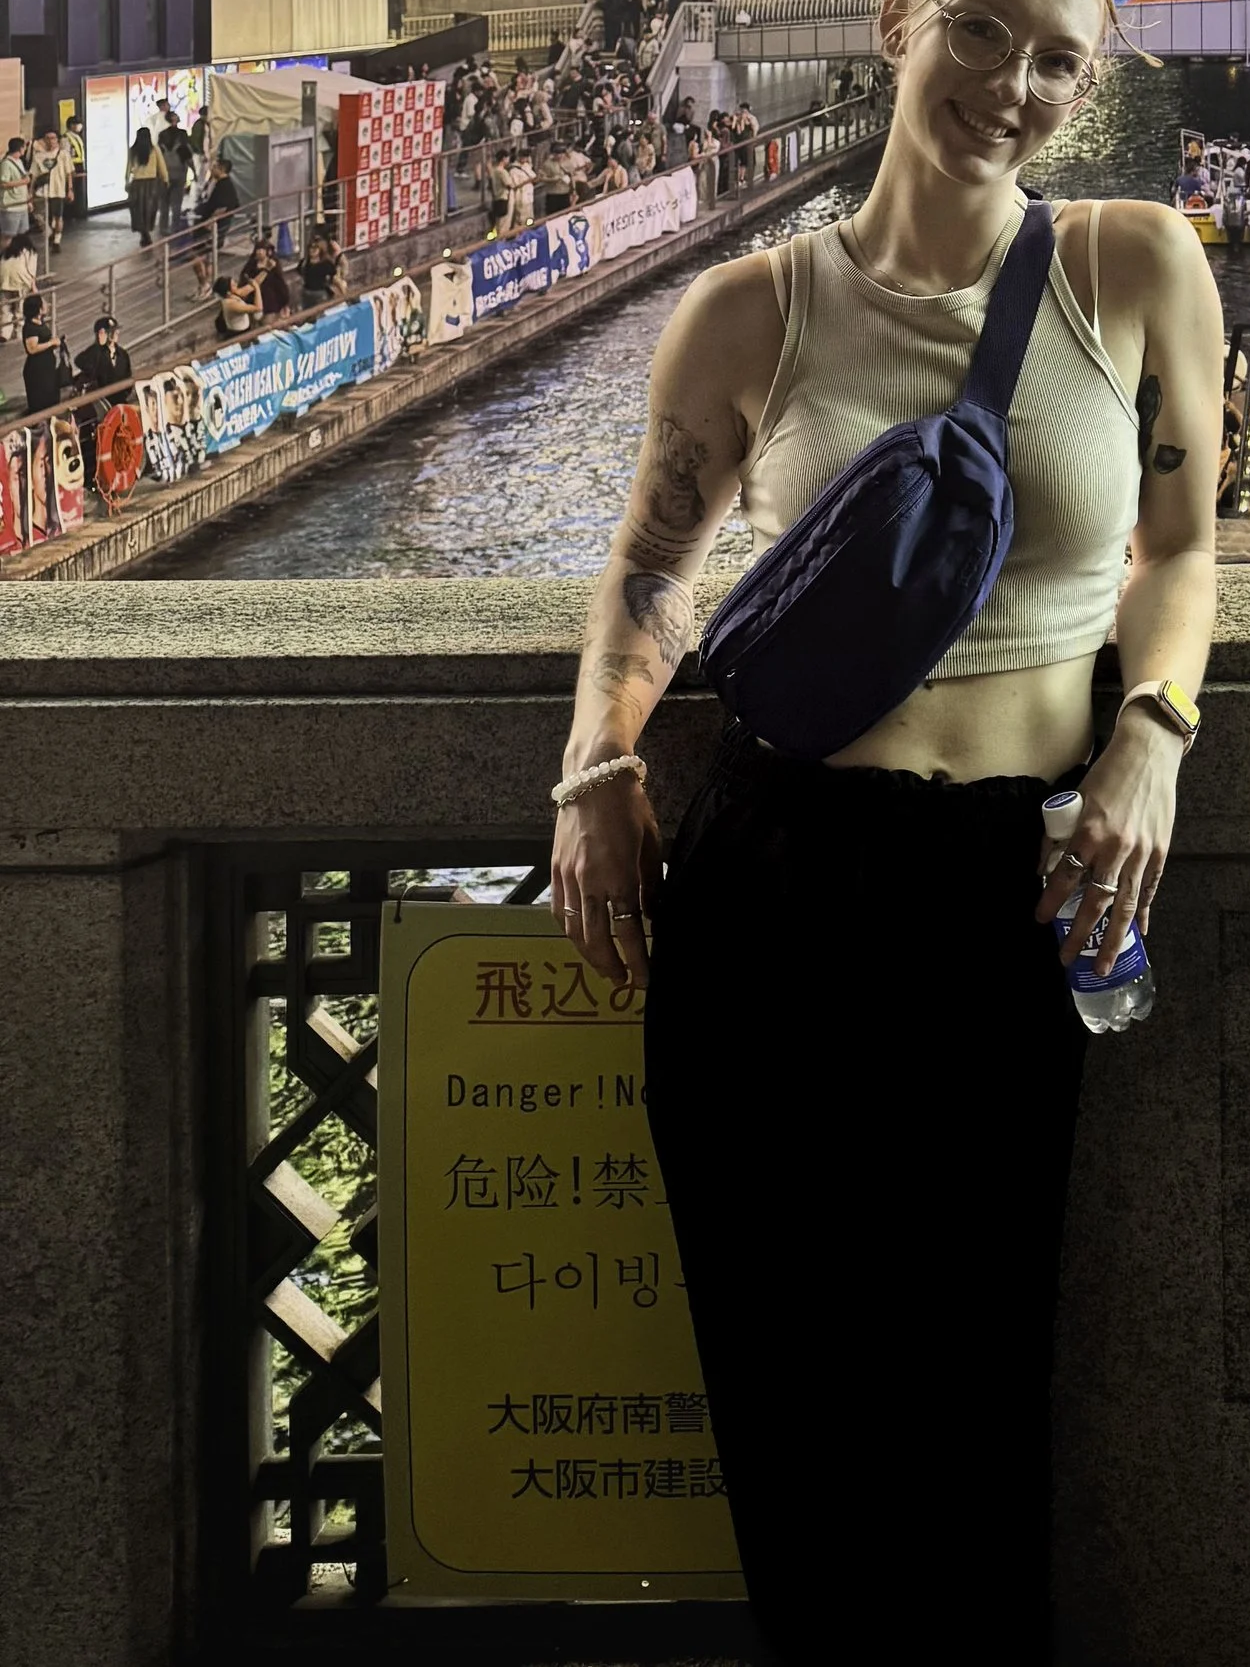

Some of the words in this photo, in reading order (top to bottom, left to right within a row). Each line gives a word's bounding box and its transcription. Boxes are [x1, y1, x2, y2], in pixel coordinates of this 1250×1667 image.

[444, 1151, 670, 1211] 危险!禁
[491, 1250, 688, 1311] 다이빙
[486, 1391, 714, 1435] 大阪府南警
